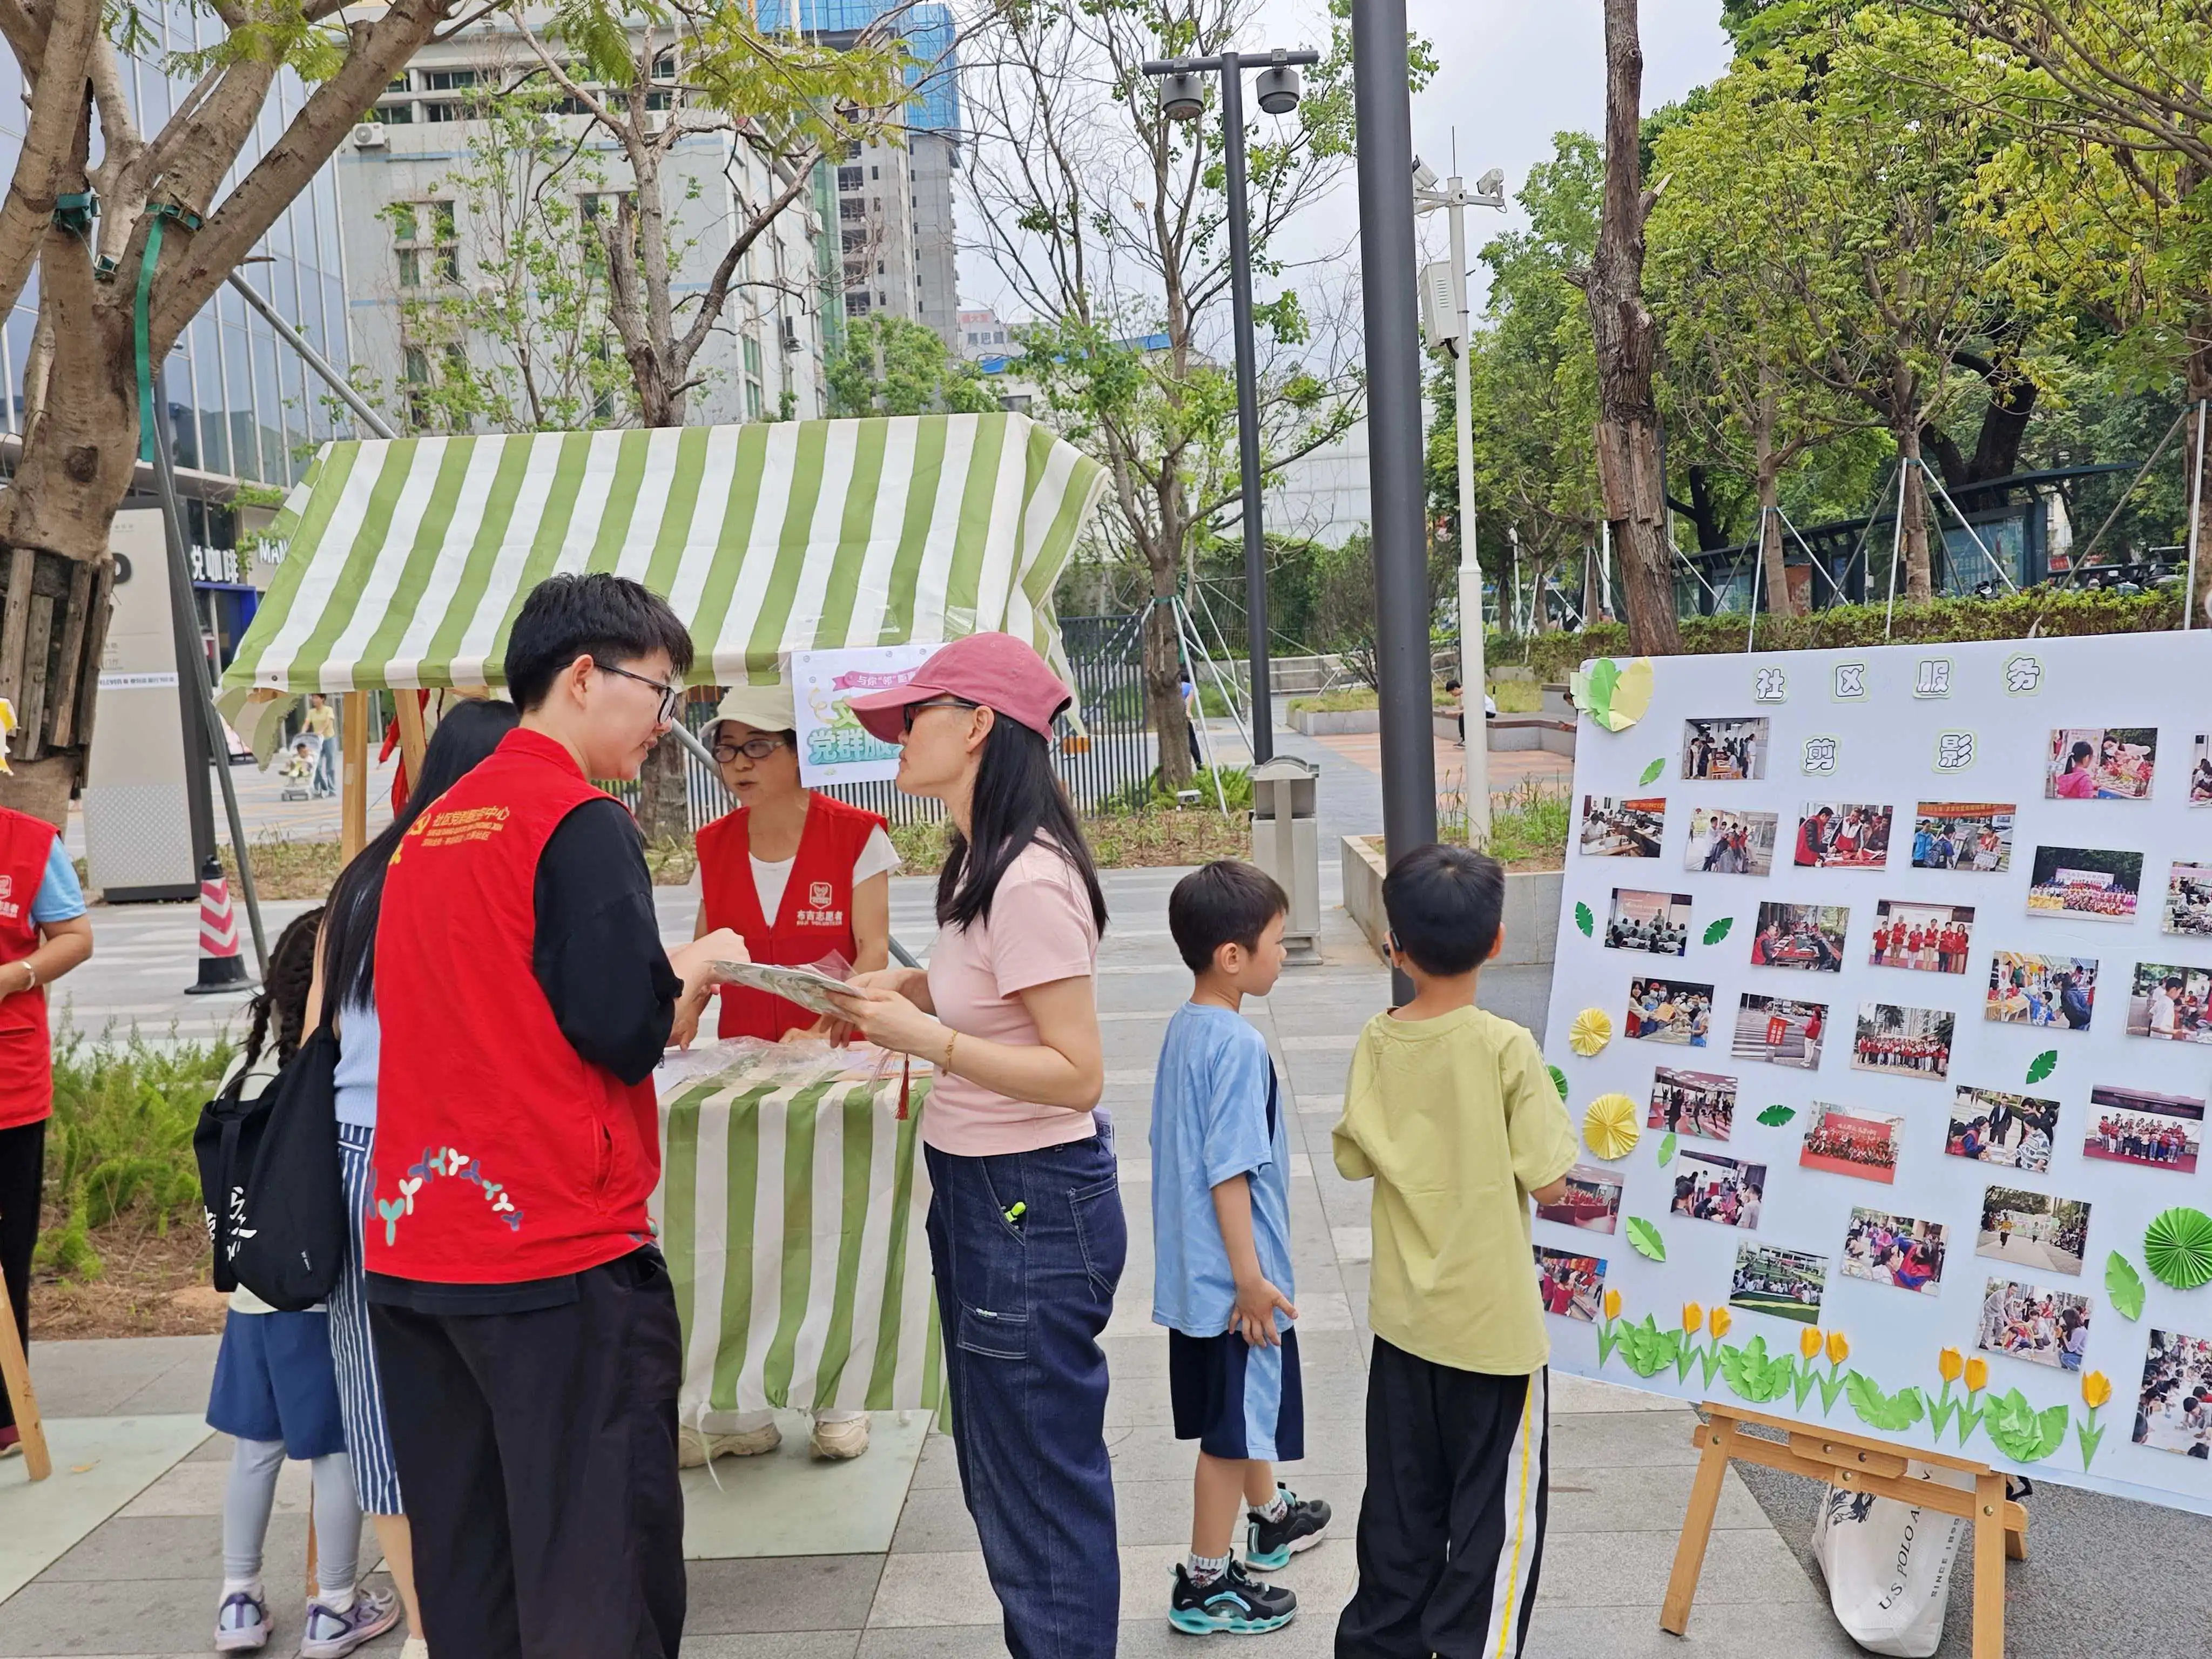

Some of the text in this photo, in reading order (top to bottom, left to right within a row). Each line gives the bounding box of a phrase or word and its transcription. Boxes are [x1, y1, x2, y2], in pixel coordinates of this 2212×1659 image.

[1756, 657, 2040, 699] 社区服务
[1805, 734, 1973, 771] 剪影
[1897, 1525, 1914, 1578] POLO
[1931, 1558, 1948, 1597] SINCE
